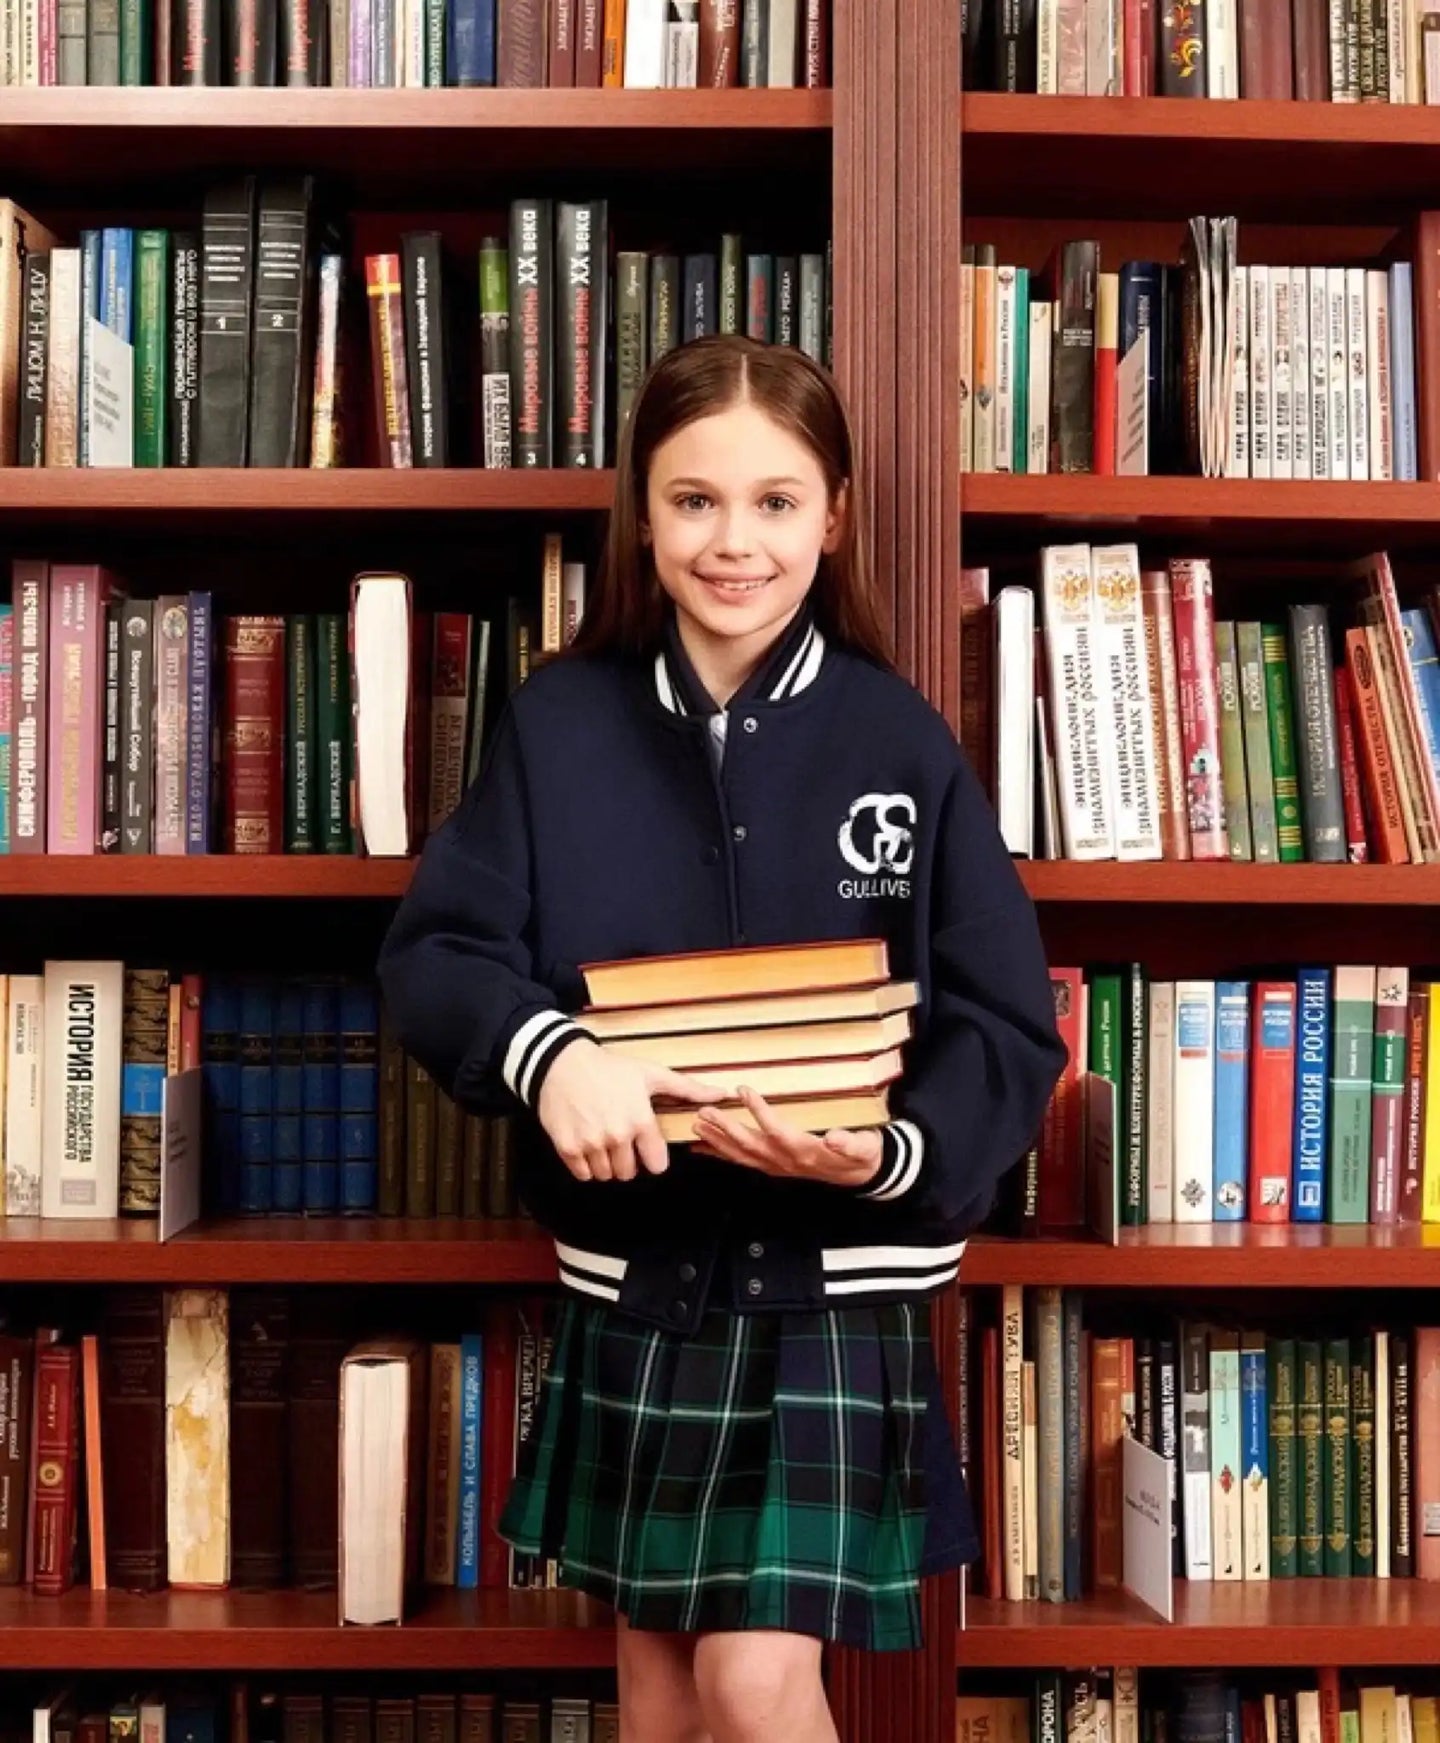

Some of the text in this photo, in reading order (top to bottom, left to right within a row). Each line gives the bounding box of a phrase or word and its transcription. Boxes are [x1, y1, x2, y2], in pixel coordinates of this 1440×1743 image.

[521, 209, 538, 252] века
[572, 209, 590, 252] века
[216, 316, 226, 330] 1
[272, 313, 283, 327] 2
[518, 288, 539, 345] войны
[569, 288, 590, 345] войны
[517, 350, 544, 433] Мировые
[568, 350, 594, 433] Мировые
[528, 451, 537, 465] 3
[575, 452, 586, 466] 4
[1301, 625, 1327, 797] ИСТОРИЯ ОТЕЧЕСТВА
[17, 717, 37, 837] СИМФЕРОПОЛЬ
[67, 983, 95, 1081] ИСТОРИЯ
[1299, 979, 1325, 1171] ИСТОРИЯ РОССИИ
[65, 1084, 79, 1161] РОССИЙСКОГО
[79, 1084, 94, 1163] ГОСУДАРСТВА
[1005, 1311, 1020, 1461] ДРЕВНЯЯ ТУВА
[461, 1356, 479, 1567] КОЛЫБЕЛЬ И СЛАВА ПРЕДКОВ
